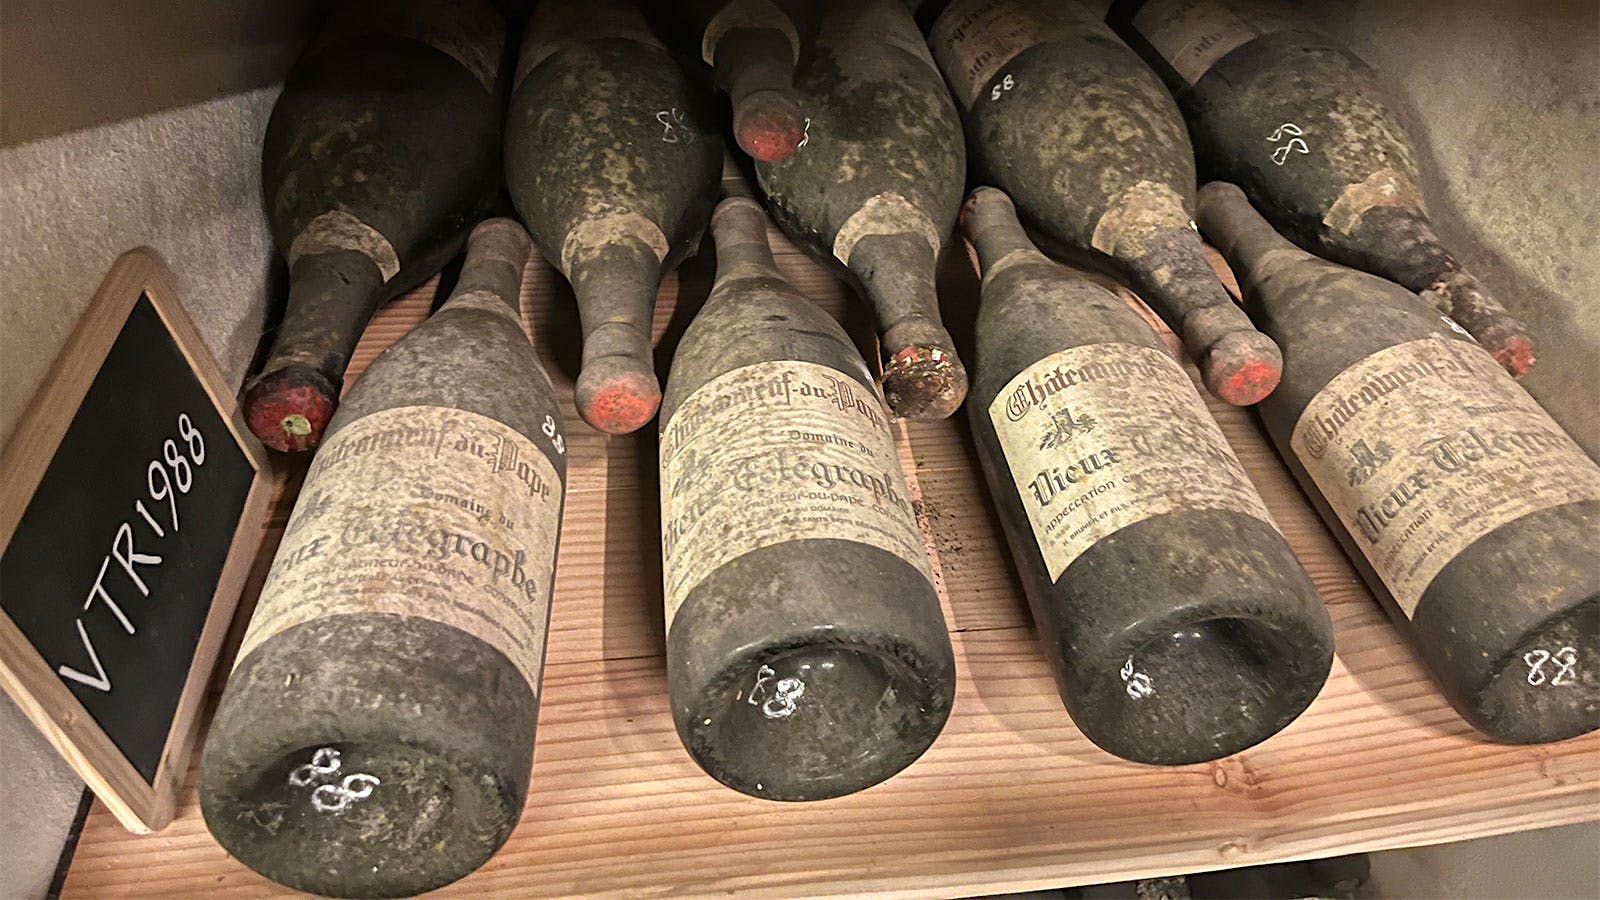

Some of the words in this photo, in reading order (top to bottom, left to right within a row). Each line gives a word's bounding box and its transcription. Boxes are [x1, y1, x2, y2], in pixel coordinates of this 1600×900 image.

[788, 429, 855, 449] Domaine
[859, 441, 876, 458] du
[1028, 446, 1123, 508] Vieux
[1045, 480, 1116, 535] APPELLATION
[1522, 645, 1578, 686] 88
